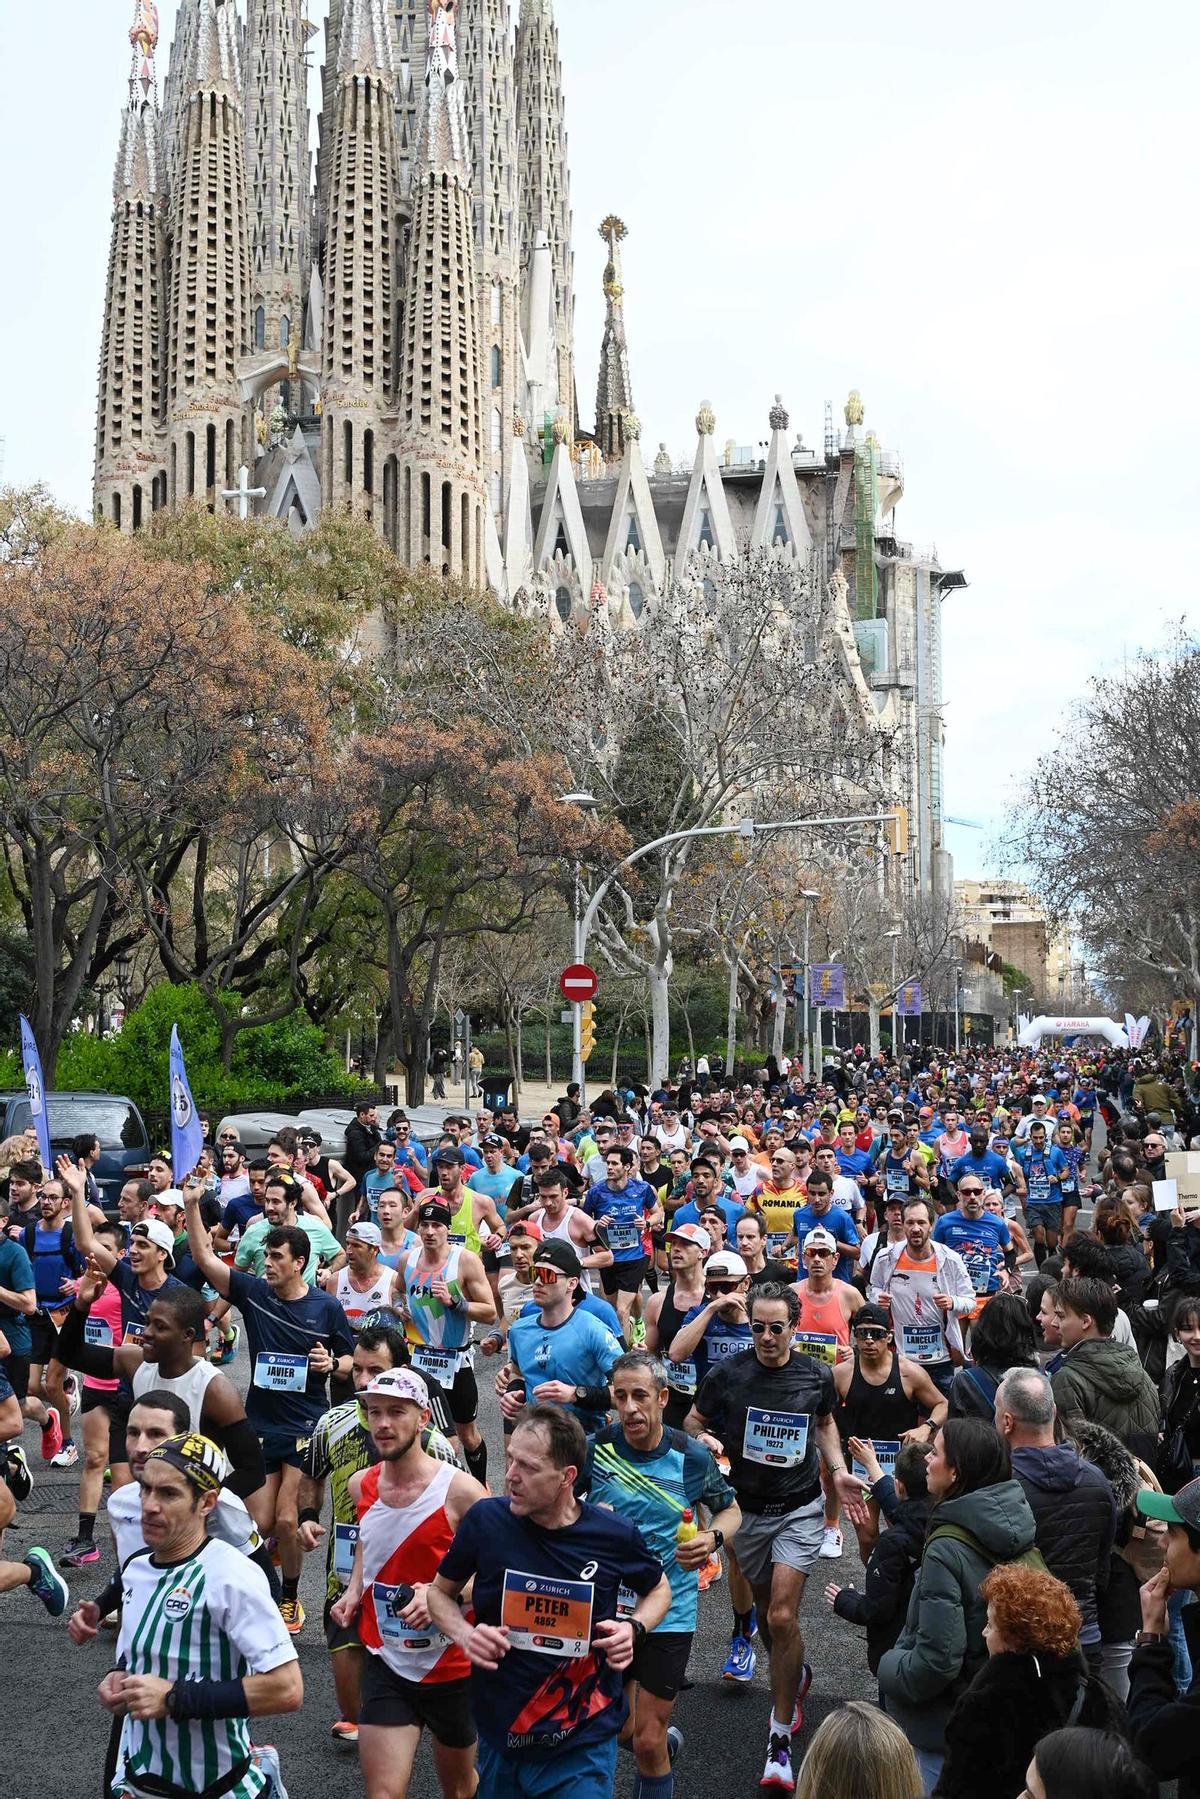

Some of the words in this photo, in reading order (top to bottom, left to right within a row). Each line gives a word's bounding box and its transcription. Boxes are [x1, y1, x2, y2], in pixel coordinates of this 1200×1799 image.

[1063, 1020, 1090, 1028] YAMAHA
[762, 1200, 801, 1209] ROMANIA
[907, 1334, 938, 1344] LANCELOT
[802, 1343, 826, 1354] PEDRO
[419, 1356, 449, 1369] THOMAS
[266, 1365, 296, 1378] JAVIER
[669, 1363, 691, 1375] SERGI
[772, 1416, 794, 1424] ZURICH
[753, 1424, 801, 1441] PHILIPPE
[765, 1439, 784, 1449] 19273
[540, 1584, 570, 1596] ZURICH
[525, 1596, 569, 1617] PETER
